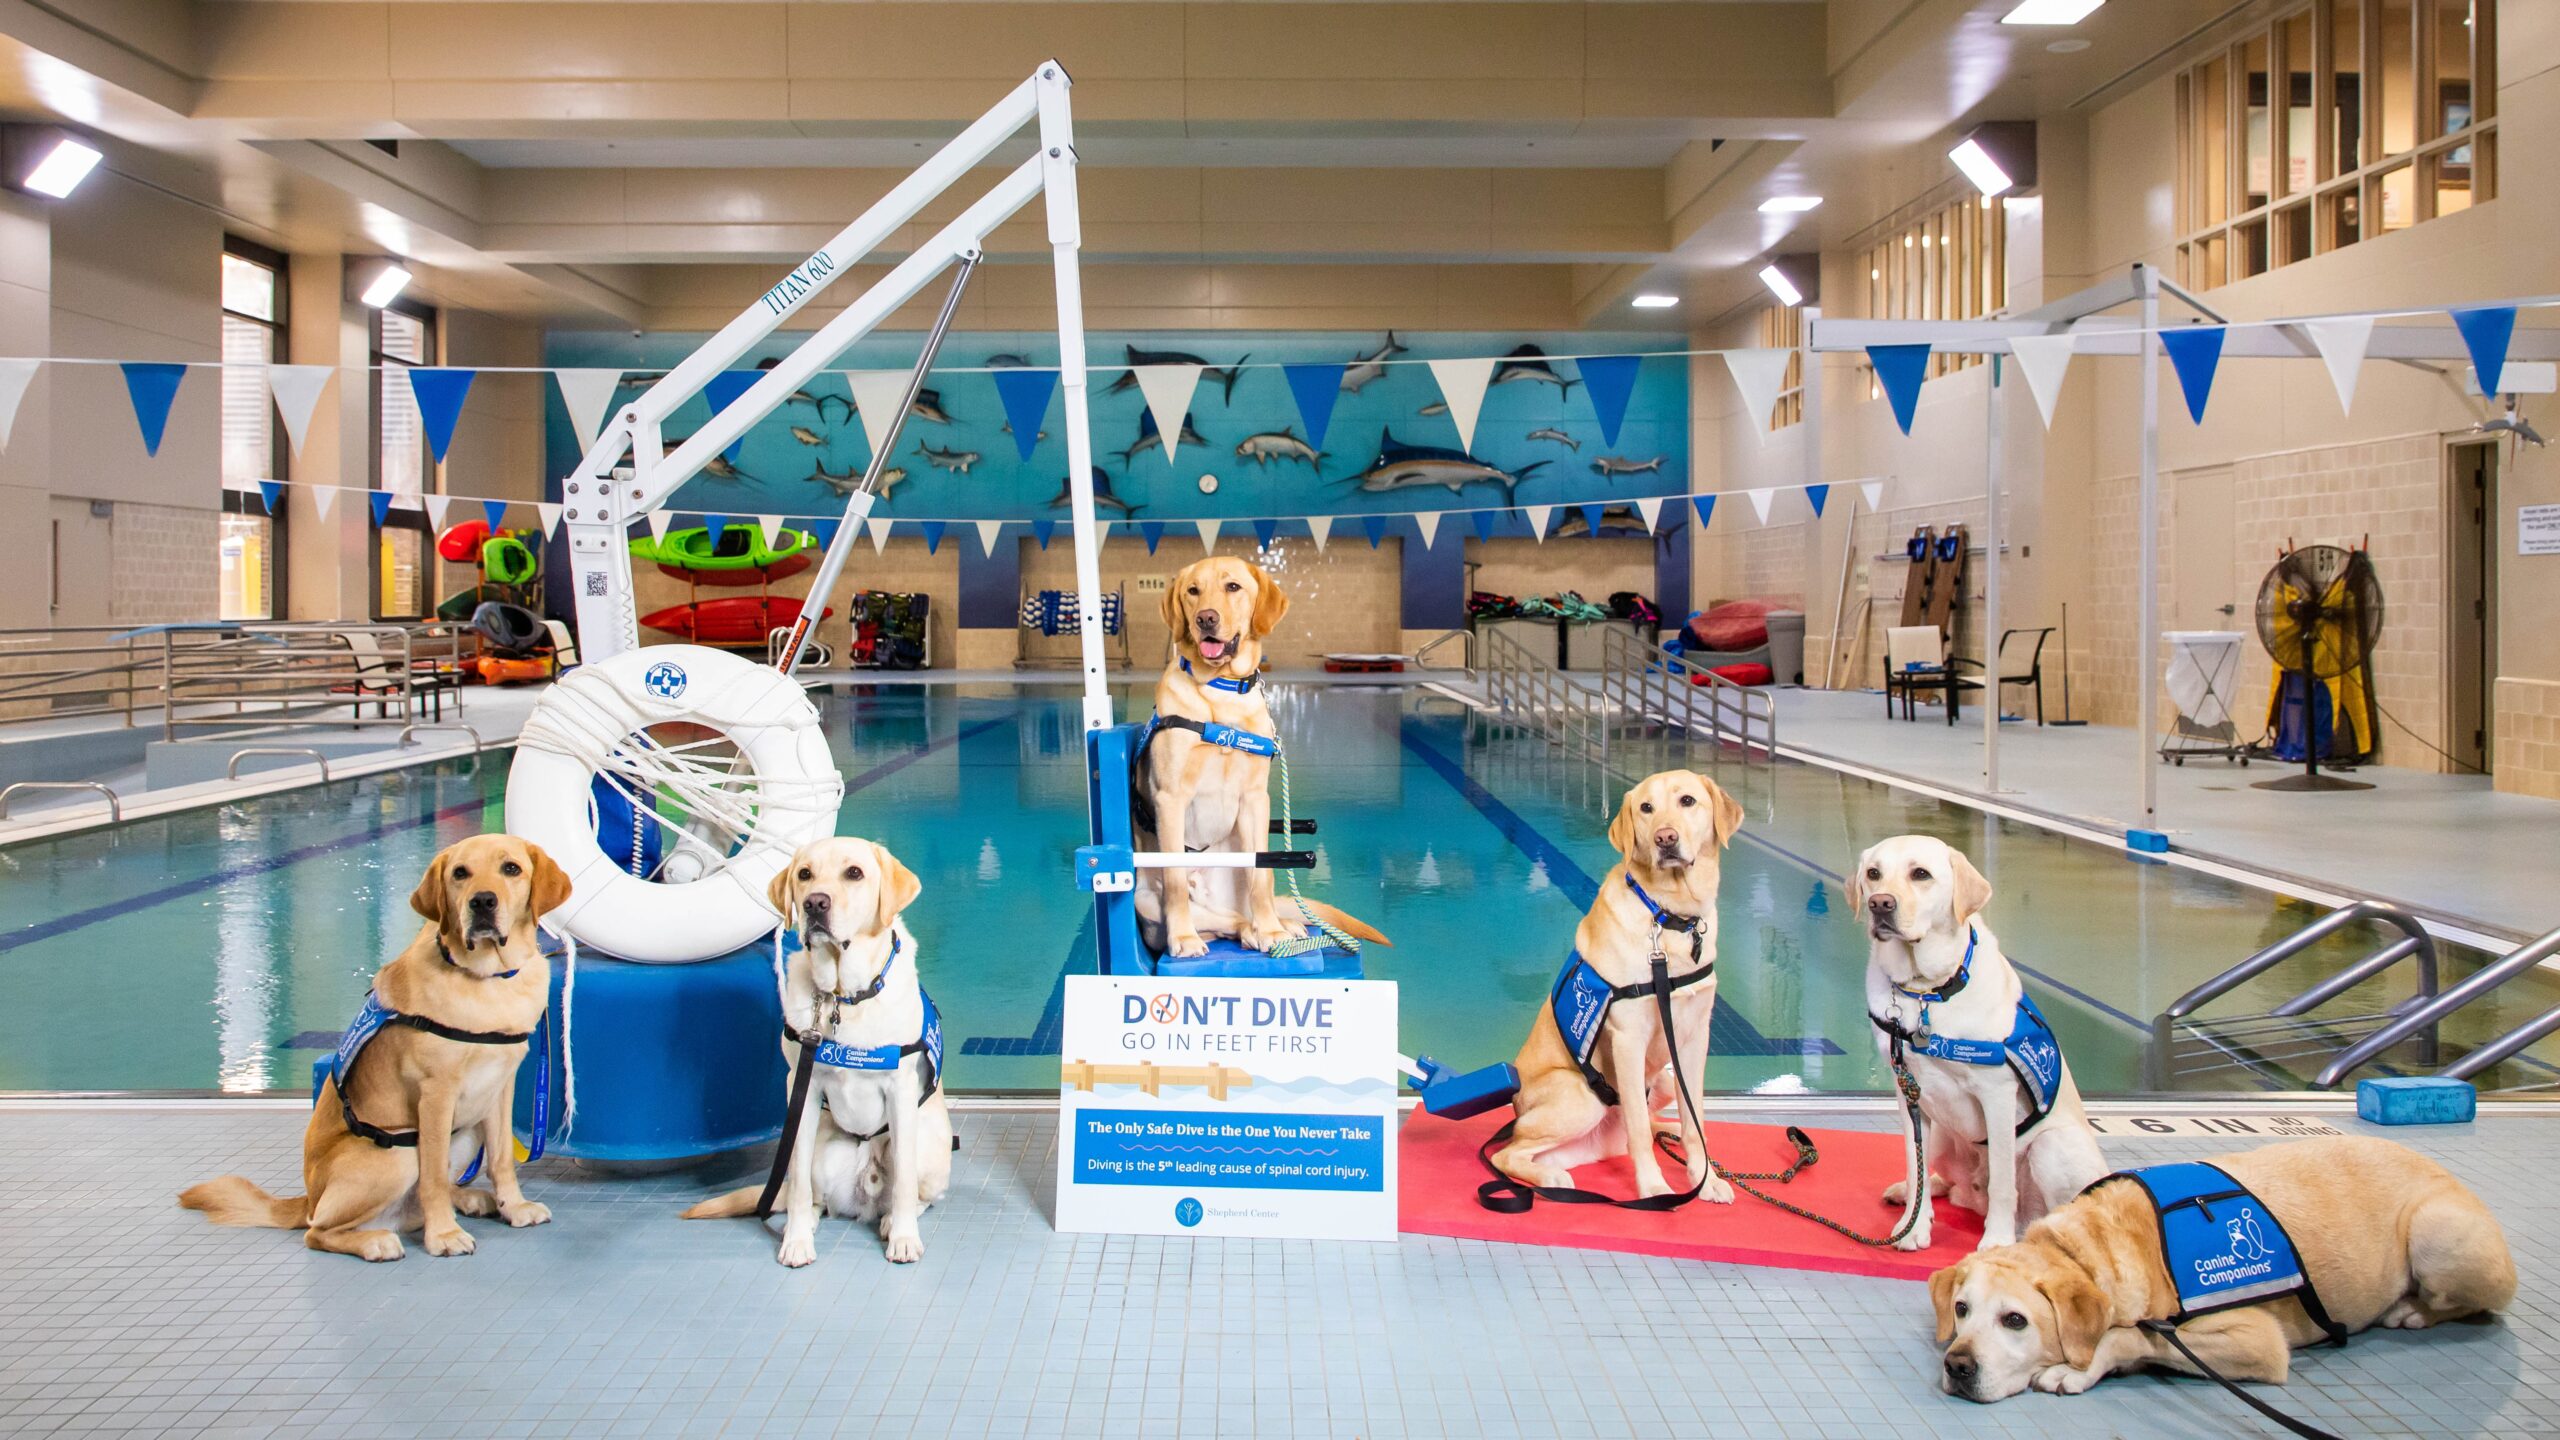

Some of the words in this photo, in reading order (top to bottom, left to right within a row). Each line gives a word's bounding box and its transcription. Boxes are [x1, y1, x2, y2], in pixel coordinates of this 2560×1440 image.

[761, 268, 812, 316] TITAN
[807, 251, 834, 281] 600
[1252, 997, 1333, 1028] DIVE
[1570, 1009, 1584, 1034] Canine
[1575, 998, 1598, 1040] Companions
[1122, 1032, 1155, 1050] GO
[1168, 1033, 1190, 1051] IN
[1203, 1034, 1256, 1052] FEET
[1269, 1035, 1332, 1054] FIRST
[845, 1054, 884, 1064] Companions
[846, 1049, 868, 1057] Canine
[1088, 1121, 1112, 1134] The
[1115, 1122, 1144, 1137] Only
[1147, 1123, 1174, 1135] Safe
[1176, 1123, 1204, 1136] Dive
[1207, 1124, 1218, 1136] is
[1221, 1125, 1241, 1137] the
[1244, 1125, 1270, 1137] One
[1273, 1126, 1297, 1138] You
[1299, 1126, 1337, 1139] Never
[1339, 1127, 1371, 1140] Take
[2130, 1118, 2176, 1133] 6
[2190, 1118, 2261, 1134] IN
[2268, 1126, 2344, 1136] DIVING
[2270, 1117, 2304, 1126] NO
[1088, 1159, 1122, 1174] Diving
[1125, 1159, 1135, 1171] is
[1137, 1160, 1156, 1171] the
[1158, 1160, 1173, 1172] 5th
[1175, 1161, 1217, 1176] leading
[1219, 1164, 1252, 1174] cause
[1254, 1162, 1267, 1174] of
[1269, 1163, 1303, 1177] spinal
[1305, 1164, 1331, 1176] cord
[1334, 1165, 1369, 1180] injury.
[1207, 1208, 1248, 1218] Shepherd
[1251, 1208, 1280, 1218] Center
[2195, 1254, 2236, 1272] Canine
[2199, 1261, 2272, 1286] Companions
